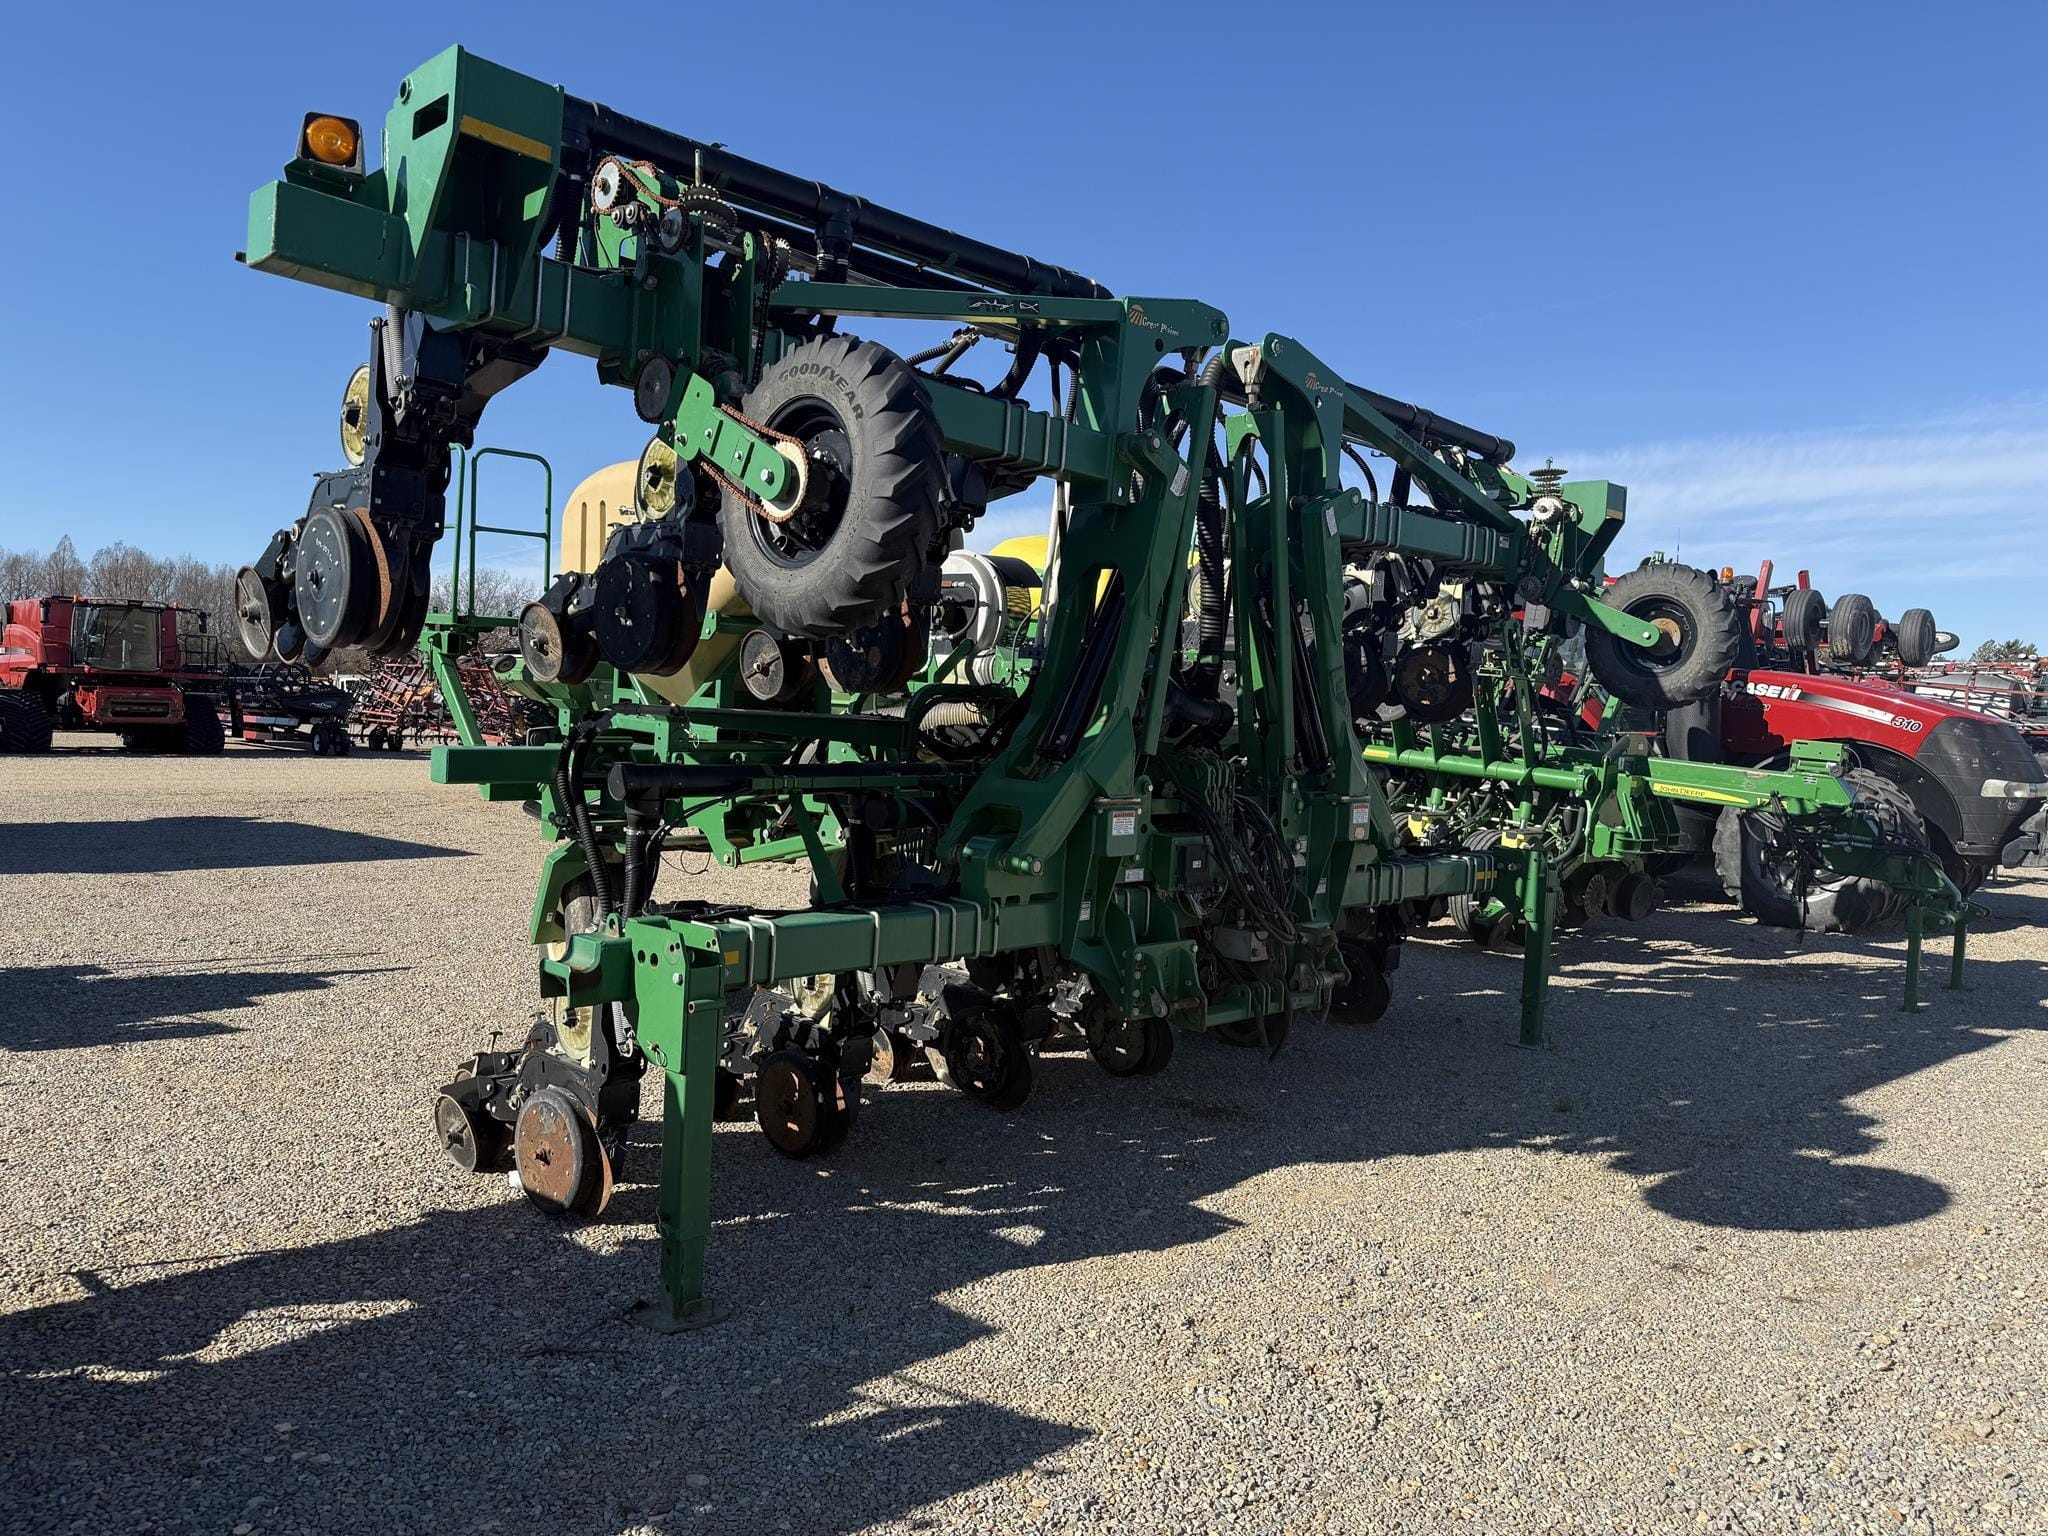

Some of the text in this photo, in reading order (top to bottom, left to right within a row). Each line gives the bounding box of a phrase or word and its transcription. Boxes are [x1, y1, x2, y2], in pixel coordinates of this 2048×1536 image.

[779, 362, 864, 420] GOODYEAR
[1731, 679, 1782, 698] CASE
[1891, 716, 1922, 732] 310
[1679, 787, 1706, 797] DEERE
[1756, 797, 1788, 809] 175
